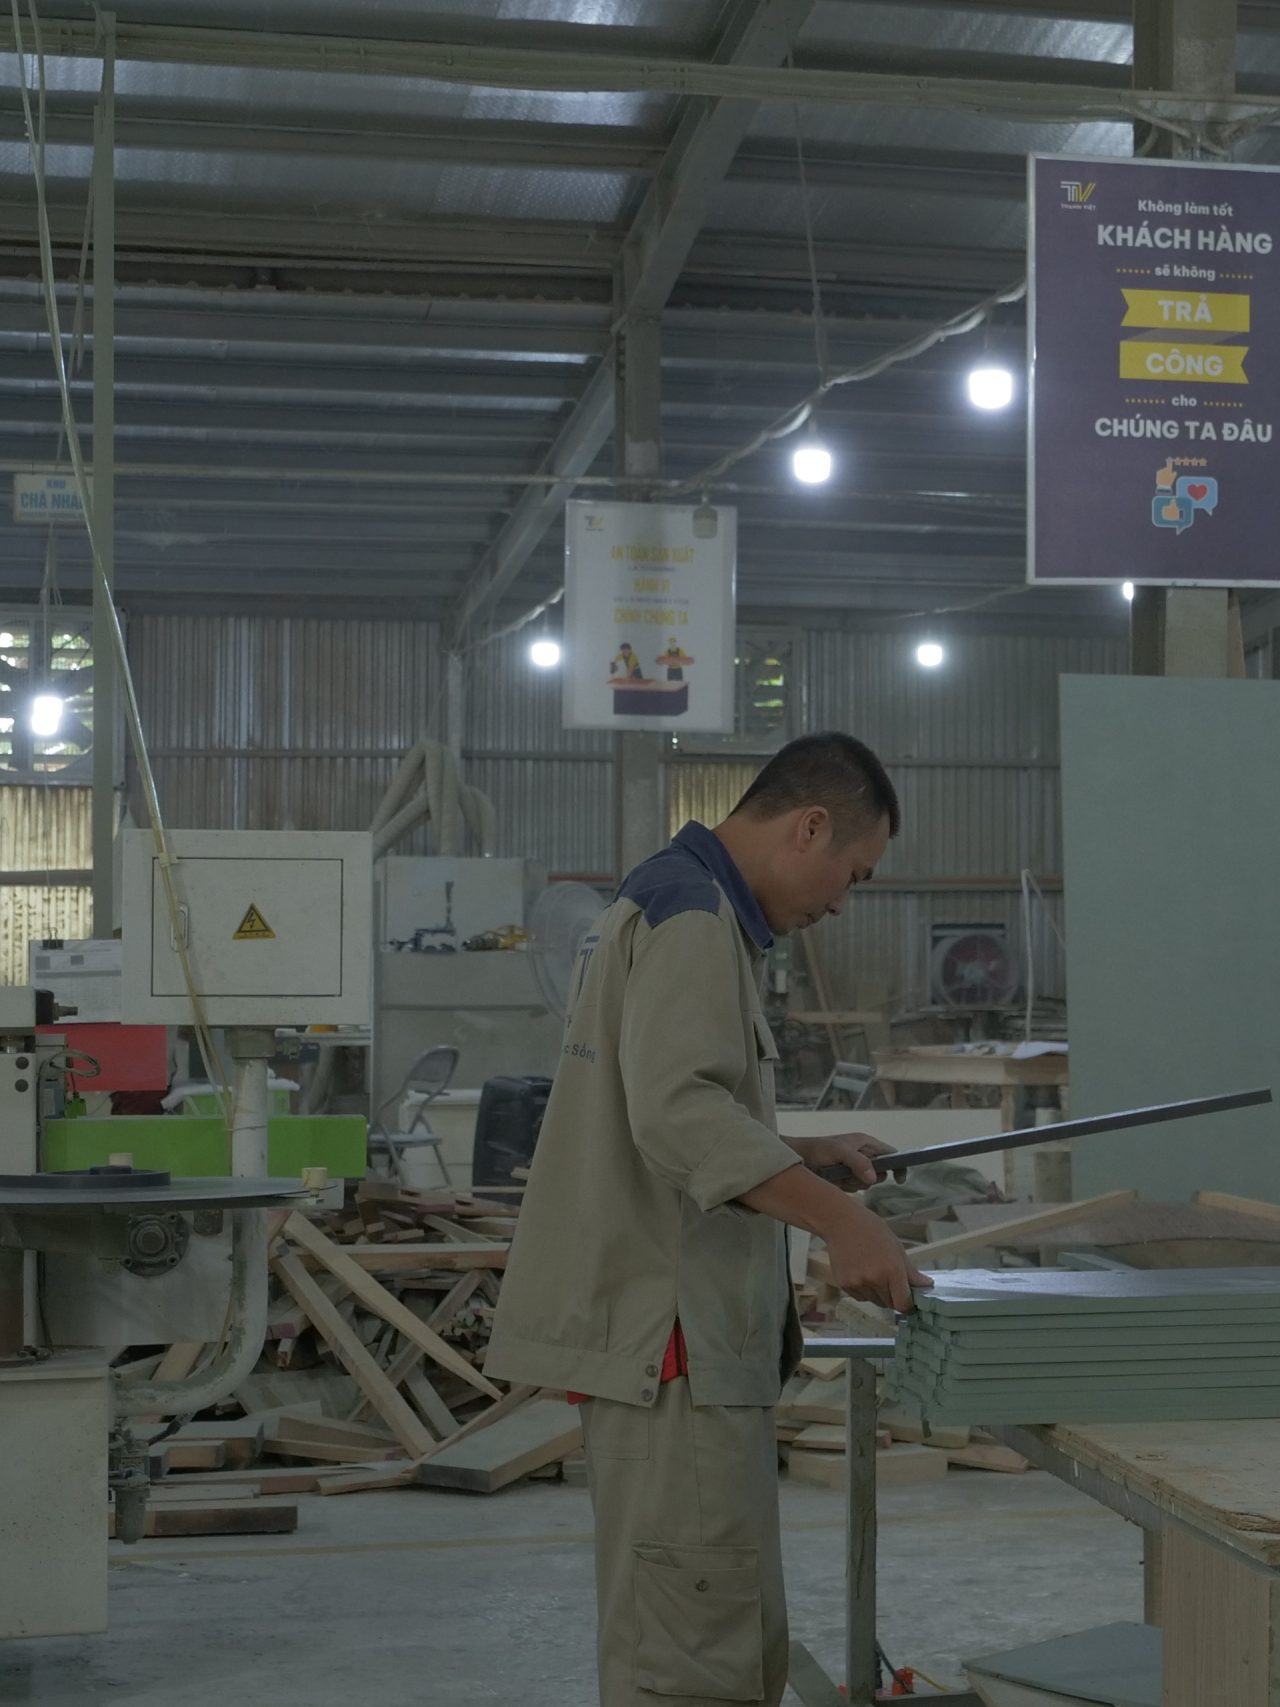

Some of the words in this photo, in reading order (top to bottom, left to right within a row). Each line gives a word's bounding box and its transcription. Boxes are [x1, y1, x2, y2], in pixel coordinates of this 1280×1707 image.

[1060, 181, 1096, 202] TV
[1138, 200, 1182, 216] Không
[1185, 202, 1210, 215] làm
[1213, 203, 1233, 217] tốt
[1097, 220, 1191, 249] KHÁCH
[1197, 225, 1273, 254] HÀNG
[1154, 264, 1171, 276] sẽ
[1173, 265, 1216, 281] không
[1158, 294, 1213, 323] TRẢ
[1146, 348, 1223, 376] CÔNG
[1171, 394, 1197, 407] cho
[1095, 414, 1180, 439] CHÚNG
[1184, 421, 1217, 440] TA
[1222, 419, 1272, 442] ĐÂU
